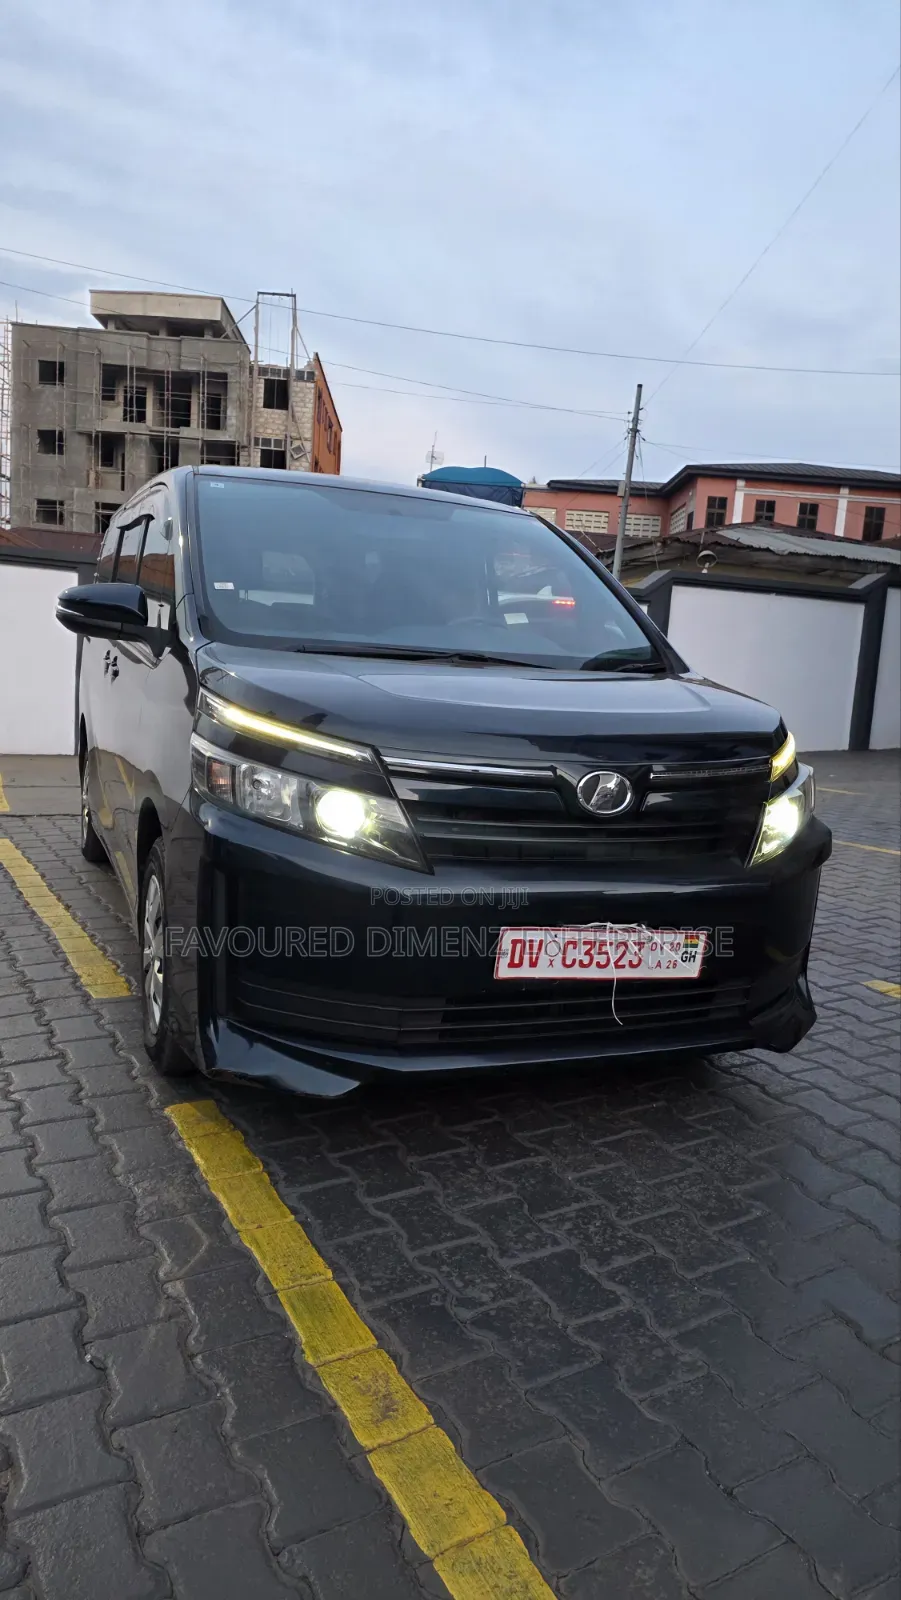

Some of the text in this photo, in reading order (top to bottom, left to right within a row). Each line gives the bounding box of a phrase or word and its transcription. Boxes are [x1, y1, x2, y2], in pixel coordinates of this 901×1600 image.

[507, 938, 645, 970] DV C3523
[680, 950, 698, 964] GH
